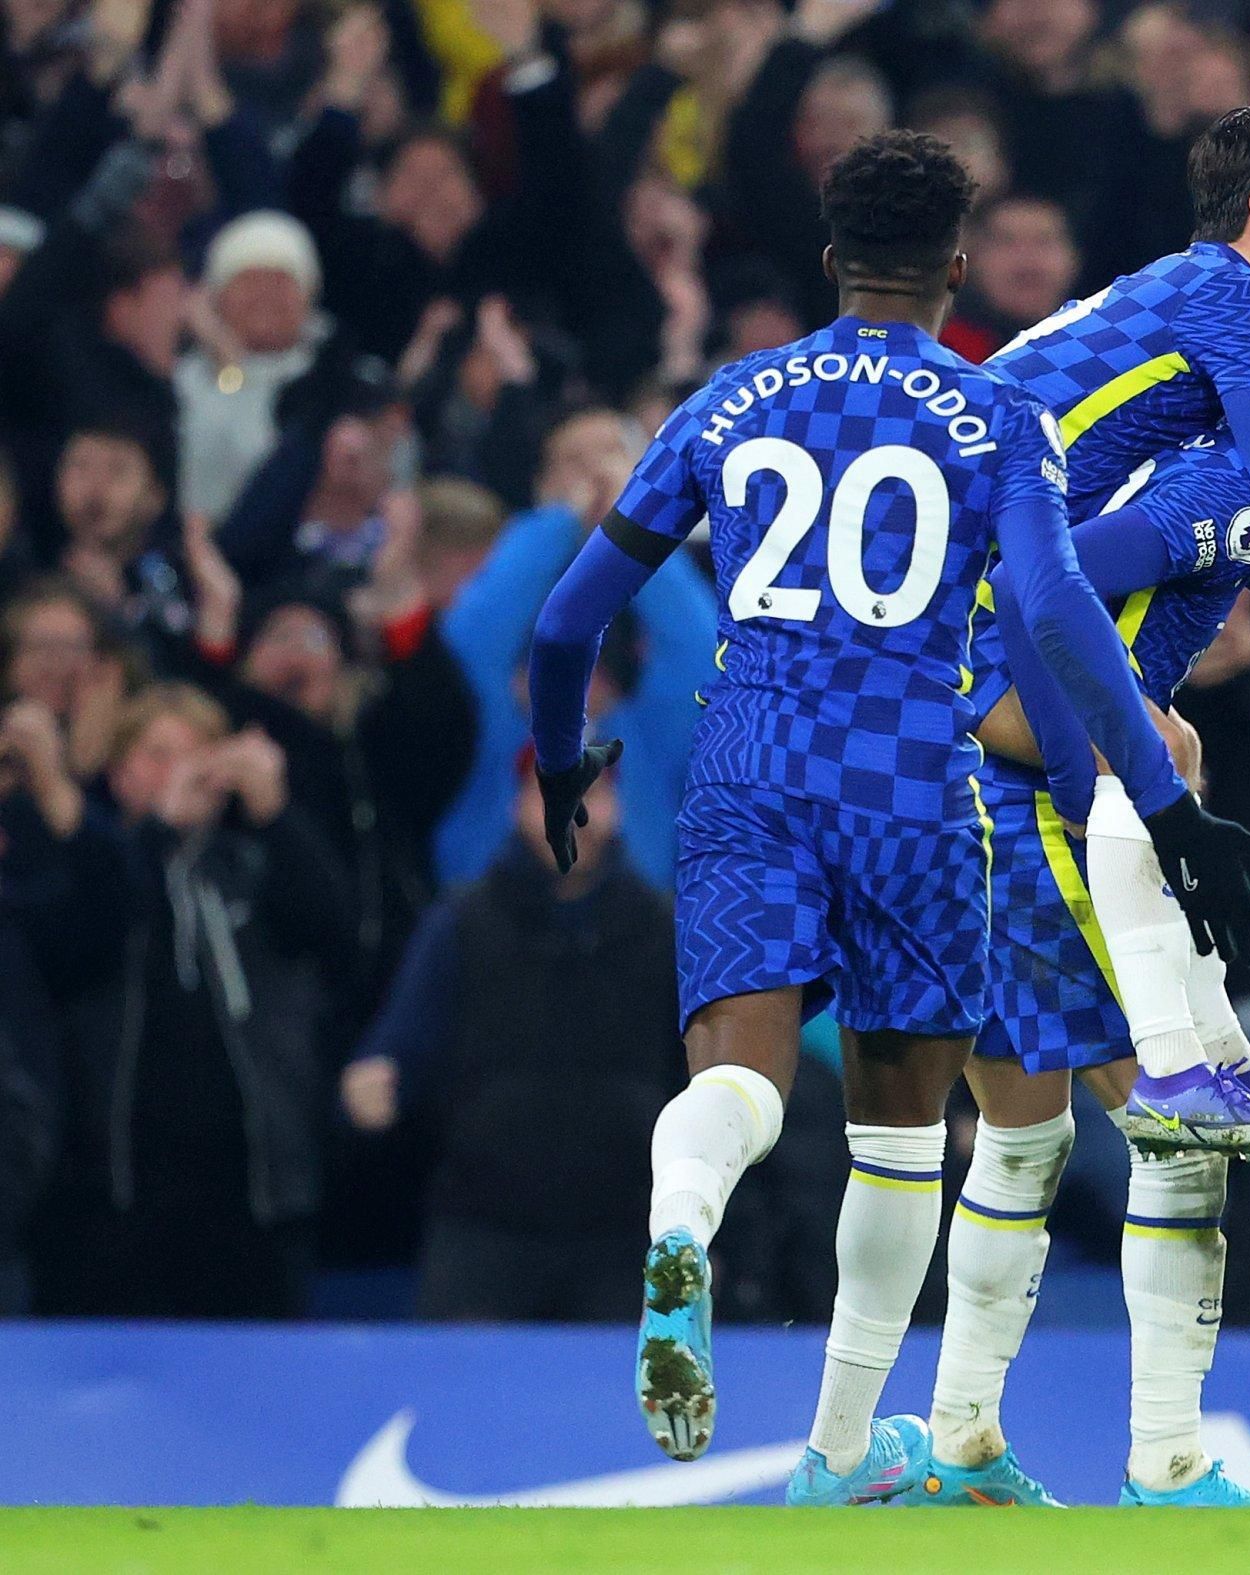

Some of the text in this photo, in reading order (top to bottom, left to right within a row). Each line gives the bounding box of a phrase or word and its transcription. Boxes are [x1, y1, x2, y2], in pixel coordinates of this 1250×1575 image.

[857, 327, 889, 339] CFC
[702, 353, 997, 458] HUDSON-ODOI
[721, 436, 950, 628] 20
[1202, 519, 1216, 540] No
[1198, 1297, 1221, 1311] CF
